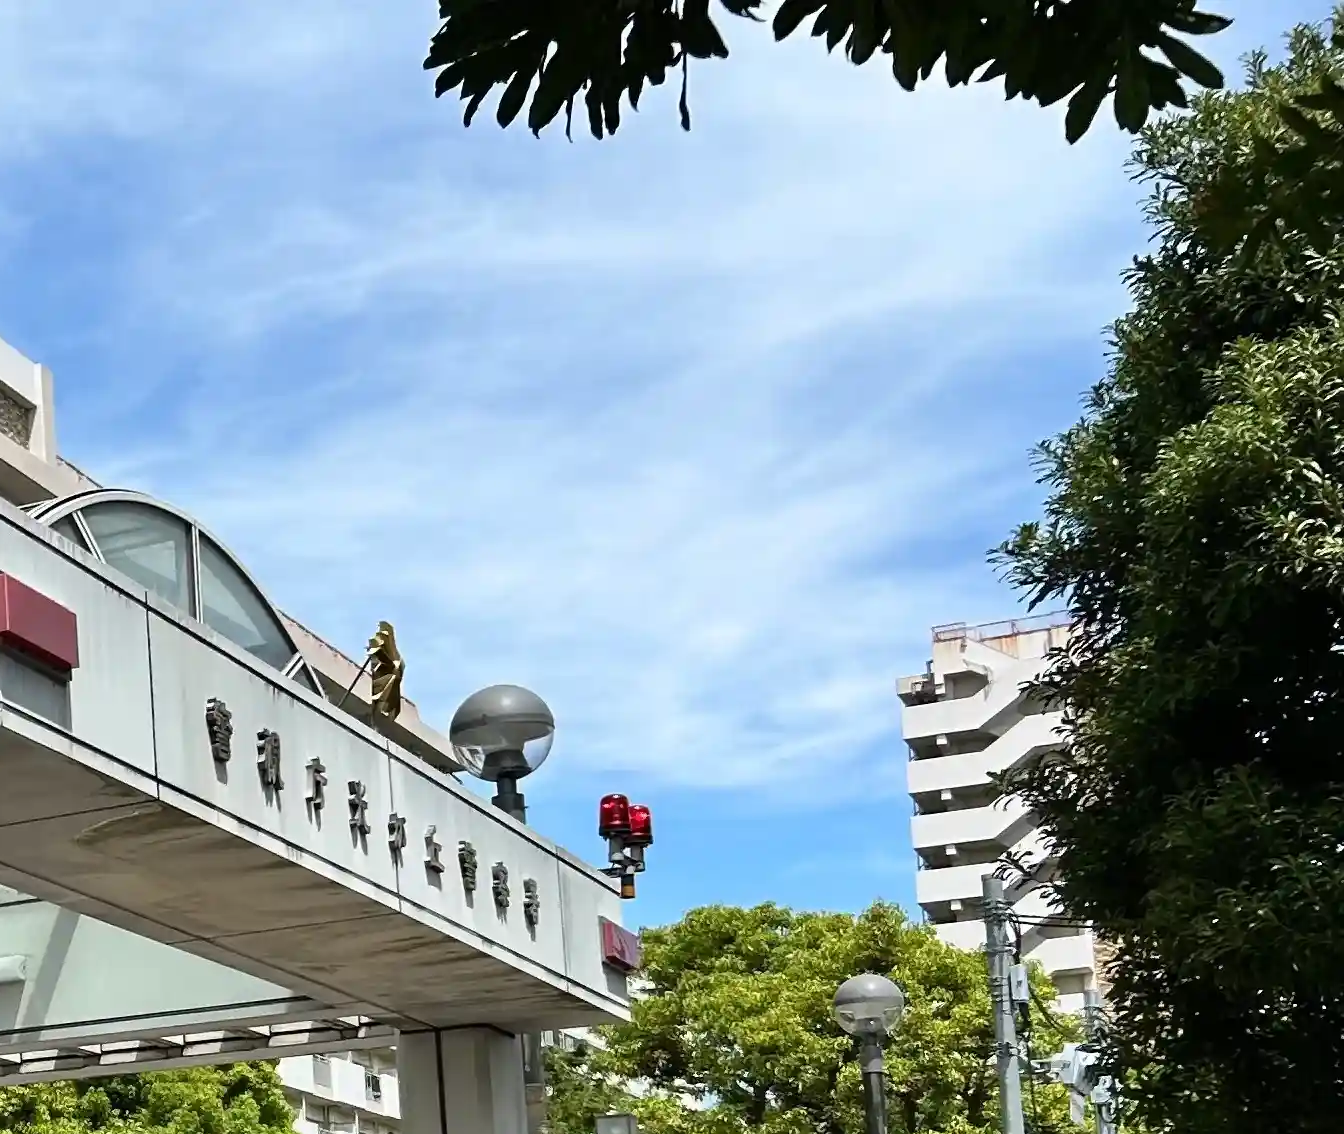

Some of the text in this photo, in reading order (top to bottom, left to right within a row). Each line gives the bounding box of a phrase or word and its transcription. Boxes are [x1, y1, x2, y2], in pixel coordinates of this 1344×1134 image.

[205, 697, 541, 927] 警視庁光が丘警察署
